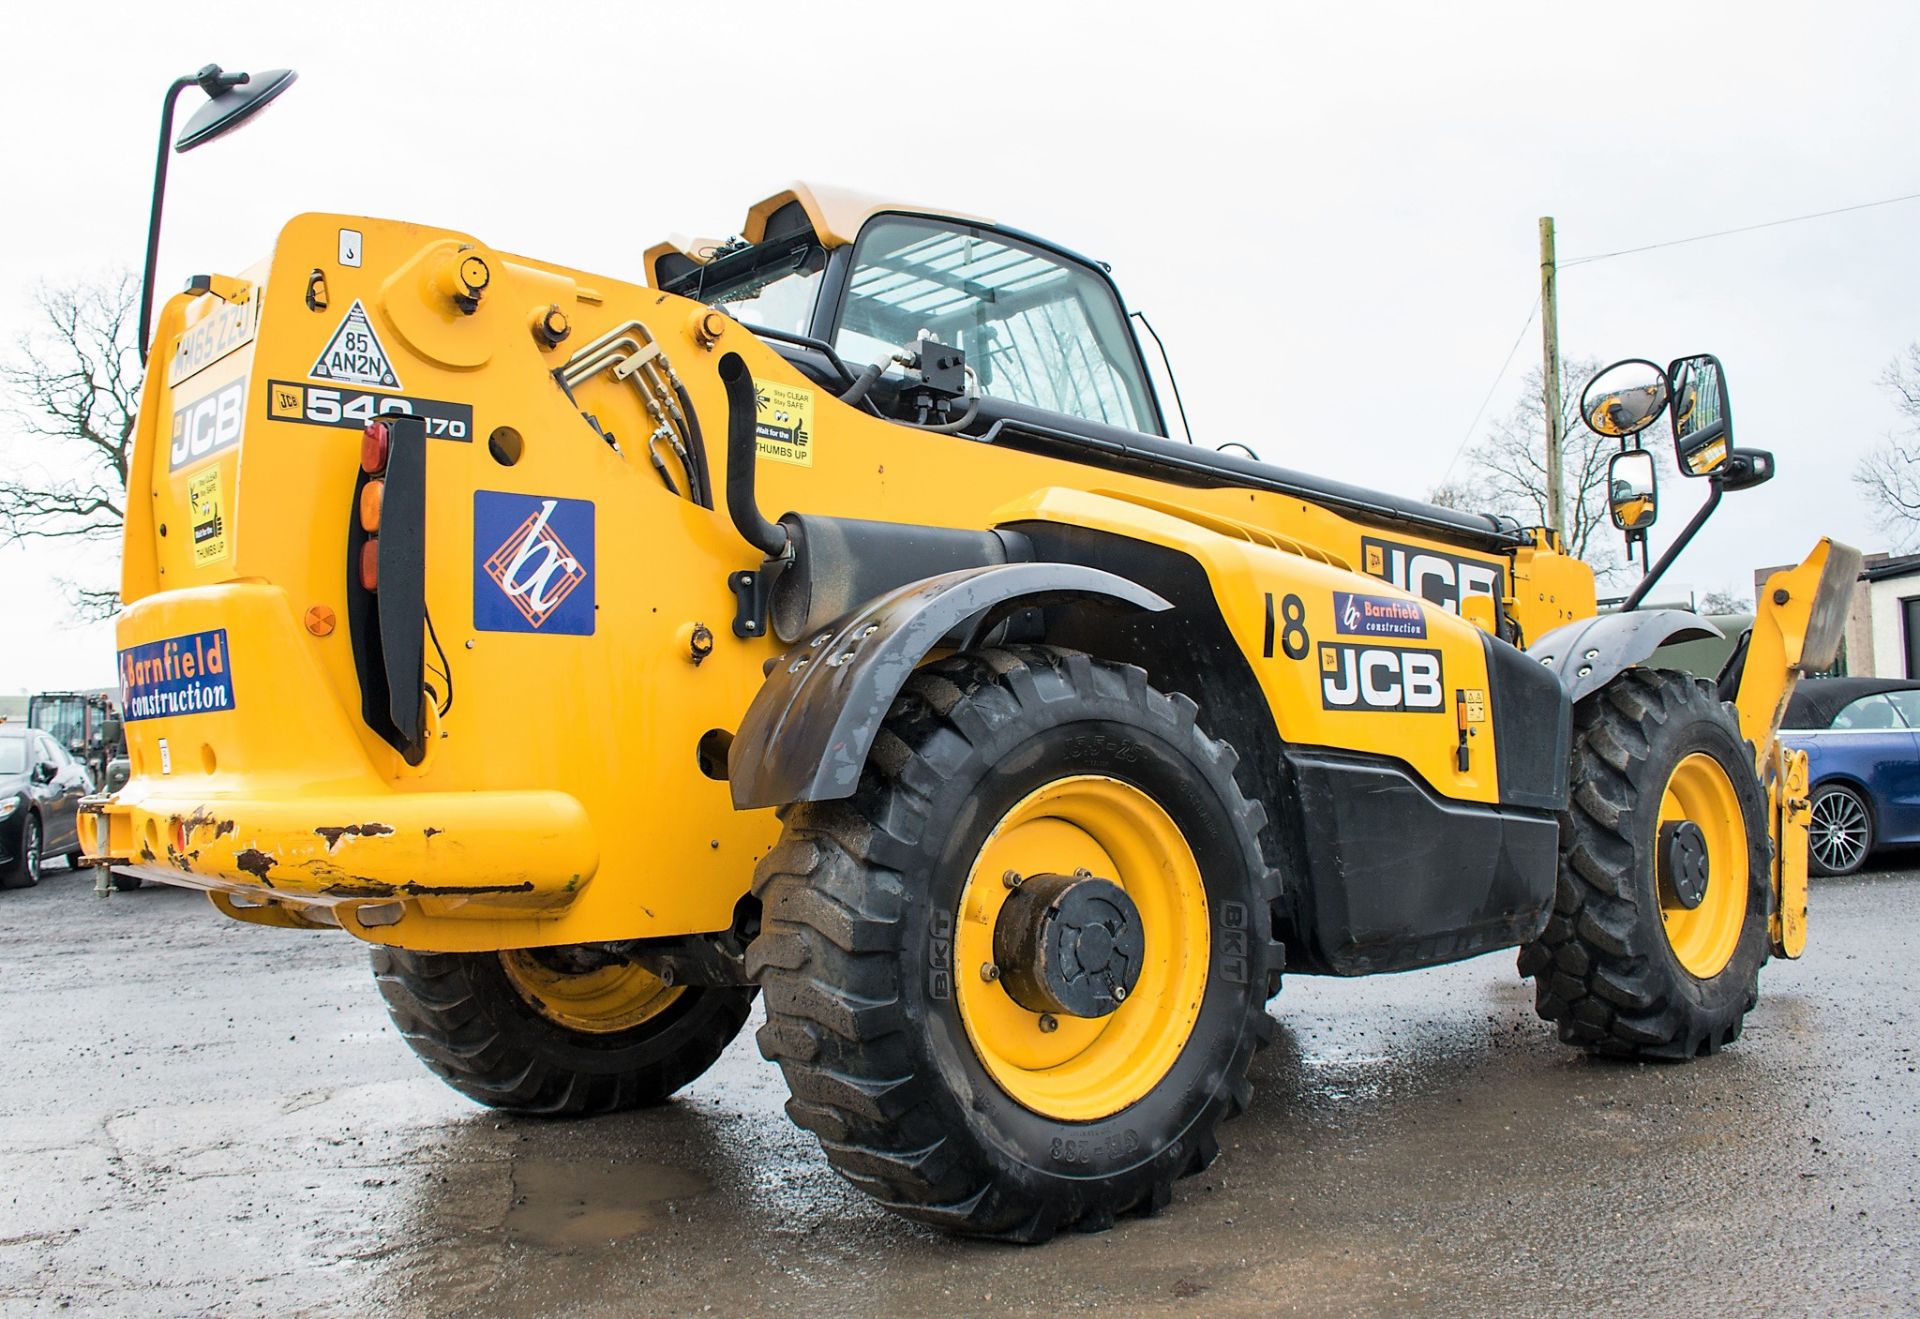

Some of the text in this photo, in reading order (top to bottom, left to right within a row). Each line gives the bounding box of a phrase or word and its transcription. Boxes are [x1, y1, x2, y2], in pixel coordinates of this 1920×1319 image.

[345, 332, 368, 353] 85
[331, 352, 381, 377] AN2N
[280, 393, 298, 408] JCB
[787, 392, 809, 402] CLEAR
[787, 401, 804, 410] SAFE
[172, 384, 242, 465] JCB
[770, 428, 778, 437] for
[779, 430, 790, 439] the
[795, 450, 807, 460] UP
[1364, 601, 1420, 620] Barnfield
[1263, 592, 1311, 660] 18
[1366, 622, 1421, 634] construction
[127, 633, 223, 687] Barnfield
[1322, 648, 1443, 708] JCB
[132, 681, 228, 717] construction
[1224, 904, 1242, 981] BKT
[935, 912, 949, 997] BKT
